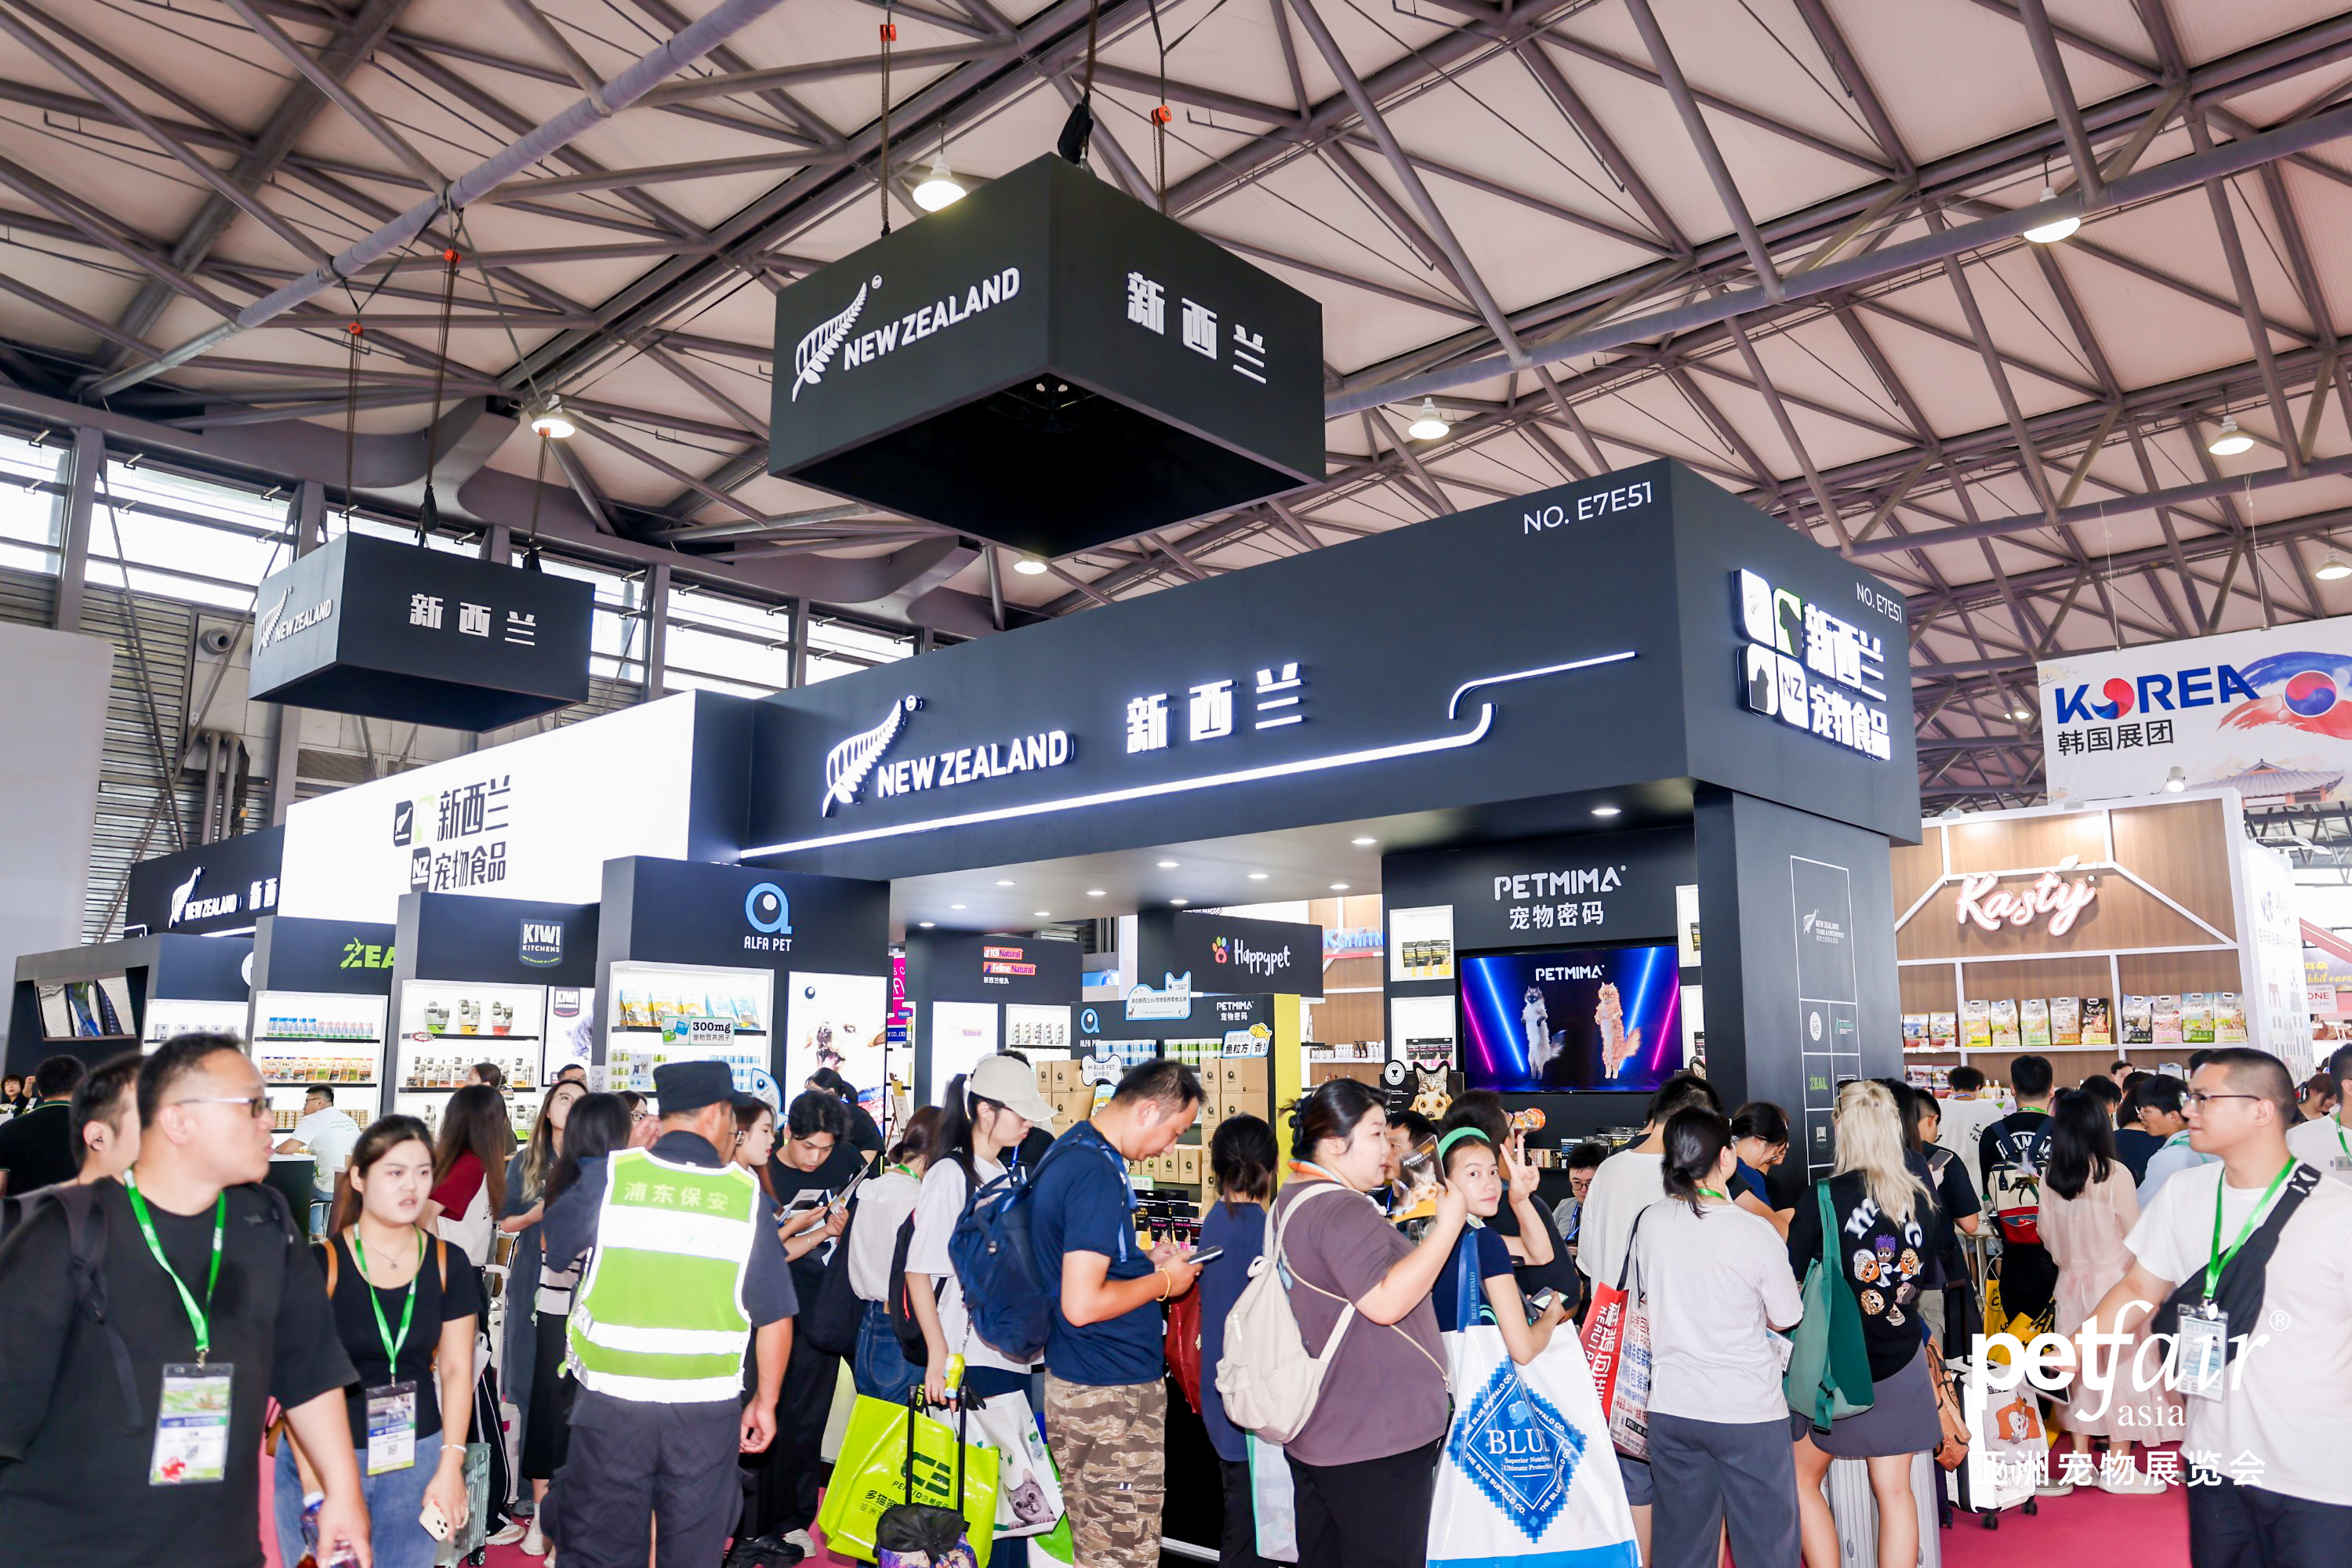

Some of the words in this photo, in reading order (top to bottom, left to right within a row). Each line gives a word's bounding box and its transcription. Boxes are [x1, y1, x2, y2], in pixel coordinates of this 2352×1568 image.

[844, 320, 902, 371] NEW
[902, 267, 1021, 347] ZEALAND
[1127, 270, 1267, 383] 新西兰
[1523, 504, 1570, 535] NO.
[1577, 481, 1653, 521] E7E51
[274, 619, 295, 642] NEW
[293, 599, 332, 633] ZEALAND
[409, 593, 535, 646] 新西兰
[1857, 582, 1875, 609] NO.
[1877, 596, 1903, 623] E7E51
[1804, 602, 1887, 702] 新西兰
[1782, 672, 1802, 702] NZ
[2055, 664, 2261, 724] KOREA
[1127, 662, 1305, 753] 新西兰
[1809, 684, 1891, 760] 宠物食品
[2057, 719, 2175, 756] 韩国展团
[877, 755, 936, 798] NEW
[939, 730, 1072, 786] ZEALAND
[437, 775, 511, 841] 新西兰
[412, 856, 430, 878] NZ
[434, 841, 506, 891] 宠物食品
[1494, 866, 1621, 901] PETMIMA
[201, 894, 238, 918] ZEALAND
[1508, 901, 1605, 931] 宠物密码
[1955, 870, 2096, 937] Kasty
[522, 944, 561, 953] KITCHENS
[523, 924, 561, 946] KIWI
[744, 935, 769, 950] ALFA
[772, 938, 793, 952] PET
[992, 963, 1011, 973] Feline
[1011, 965, 1033, 974] Natural
[1000, 949, 1021, 958] Natural
[1233, 938, 1291, 976] Happypet
[1535, 964, 1602, 982] PETMIMA
[1217, 1000, 1254, 1011] PETMIMA
[1220, 1012, 1248, 1021] 宠物密码
[692, 1022, 731, 1033] 300mg
[1225, 1044, 1249, 1054] 鱼粒方
[624, 1181, 728, 1211] 浦东保安
[1472, 1407, 1486, 1425] BLUE
[1483, 1382, 1506, 1410] BUFFALO
[1502, 1374, 1515, 1386] CO.
[1553, 1420, 1566, 1433] CO.
[1465, 1451, 1477, 1466] THE
[1475, 1462, 1490, 1481] BLUE
[1488, 1478, 1516, 1507] BUFFALO
[1514, 1501, 1526, 1515] CO.
[1538, 1498, 1551, 1512] THE
[1548, 1483, 1563, 1501] BLUE
